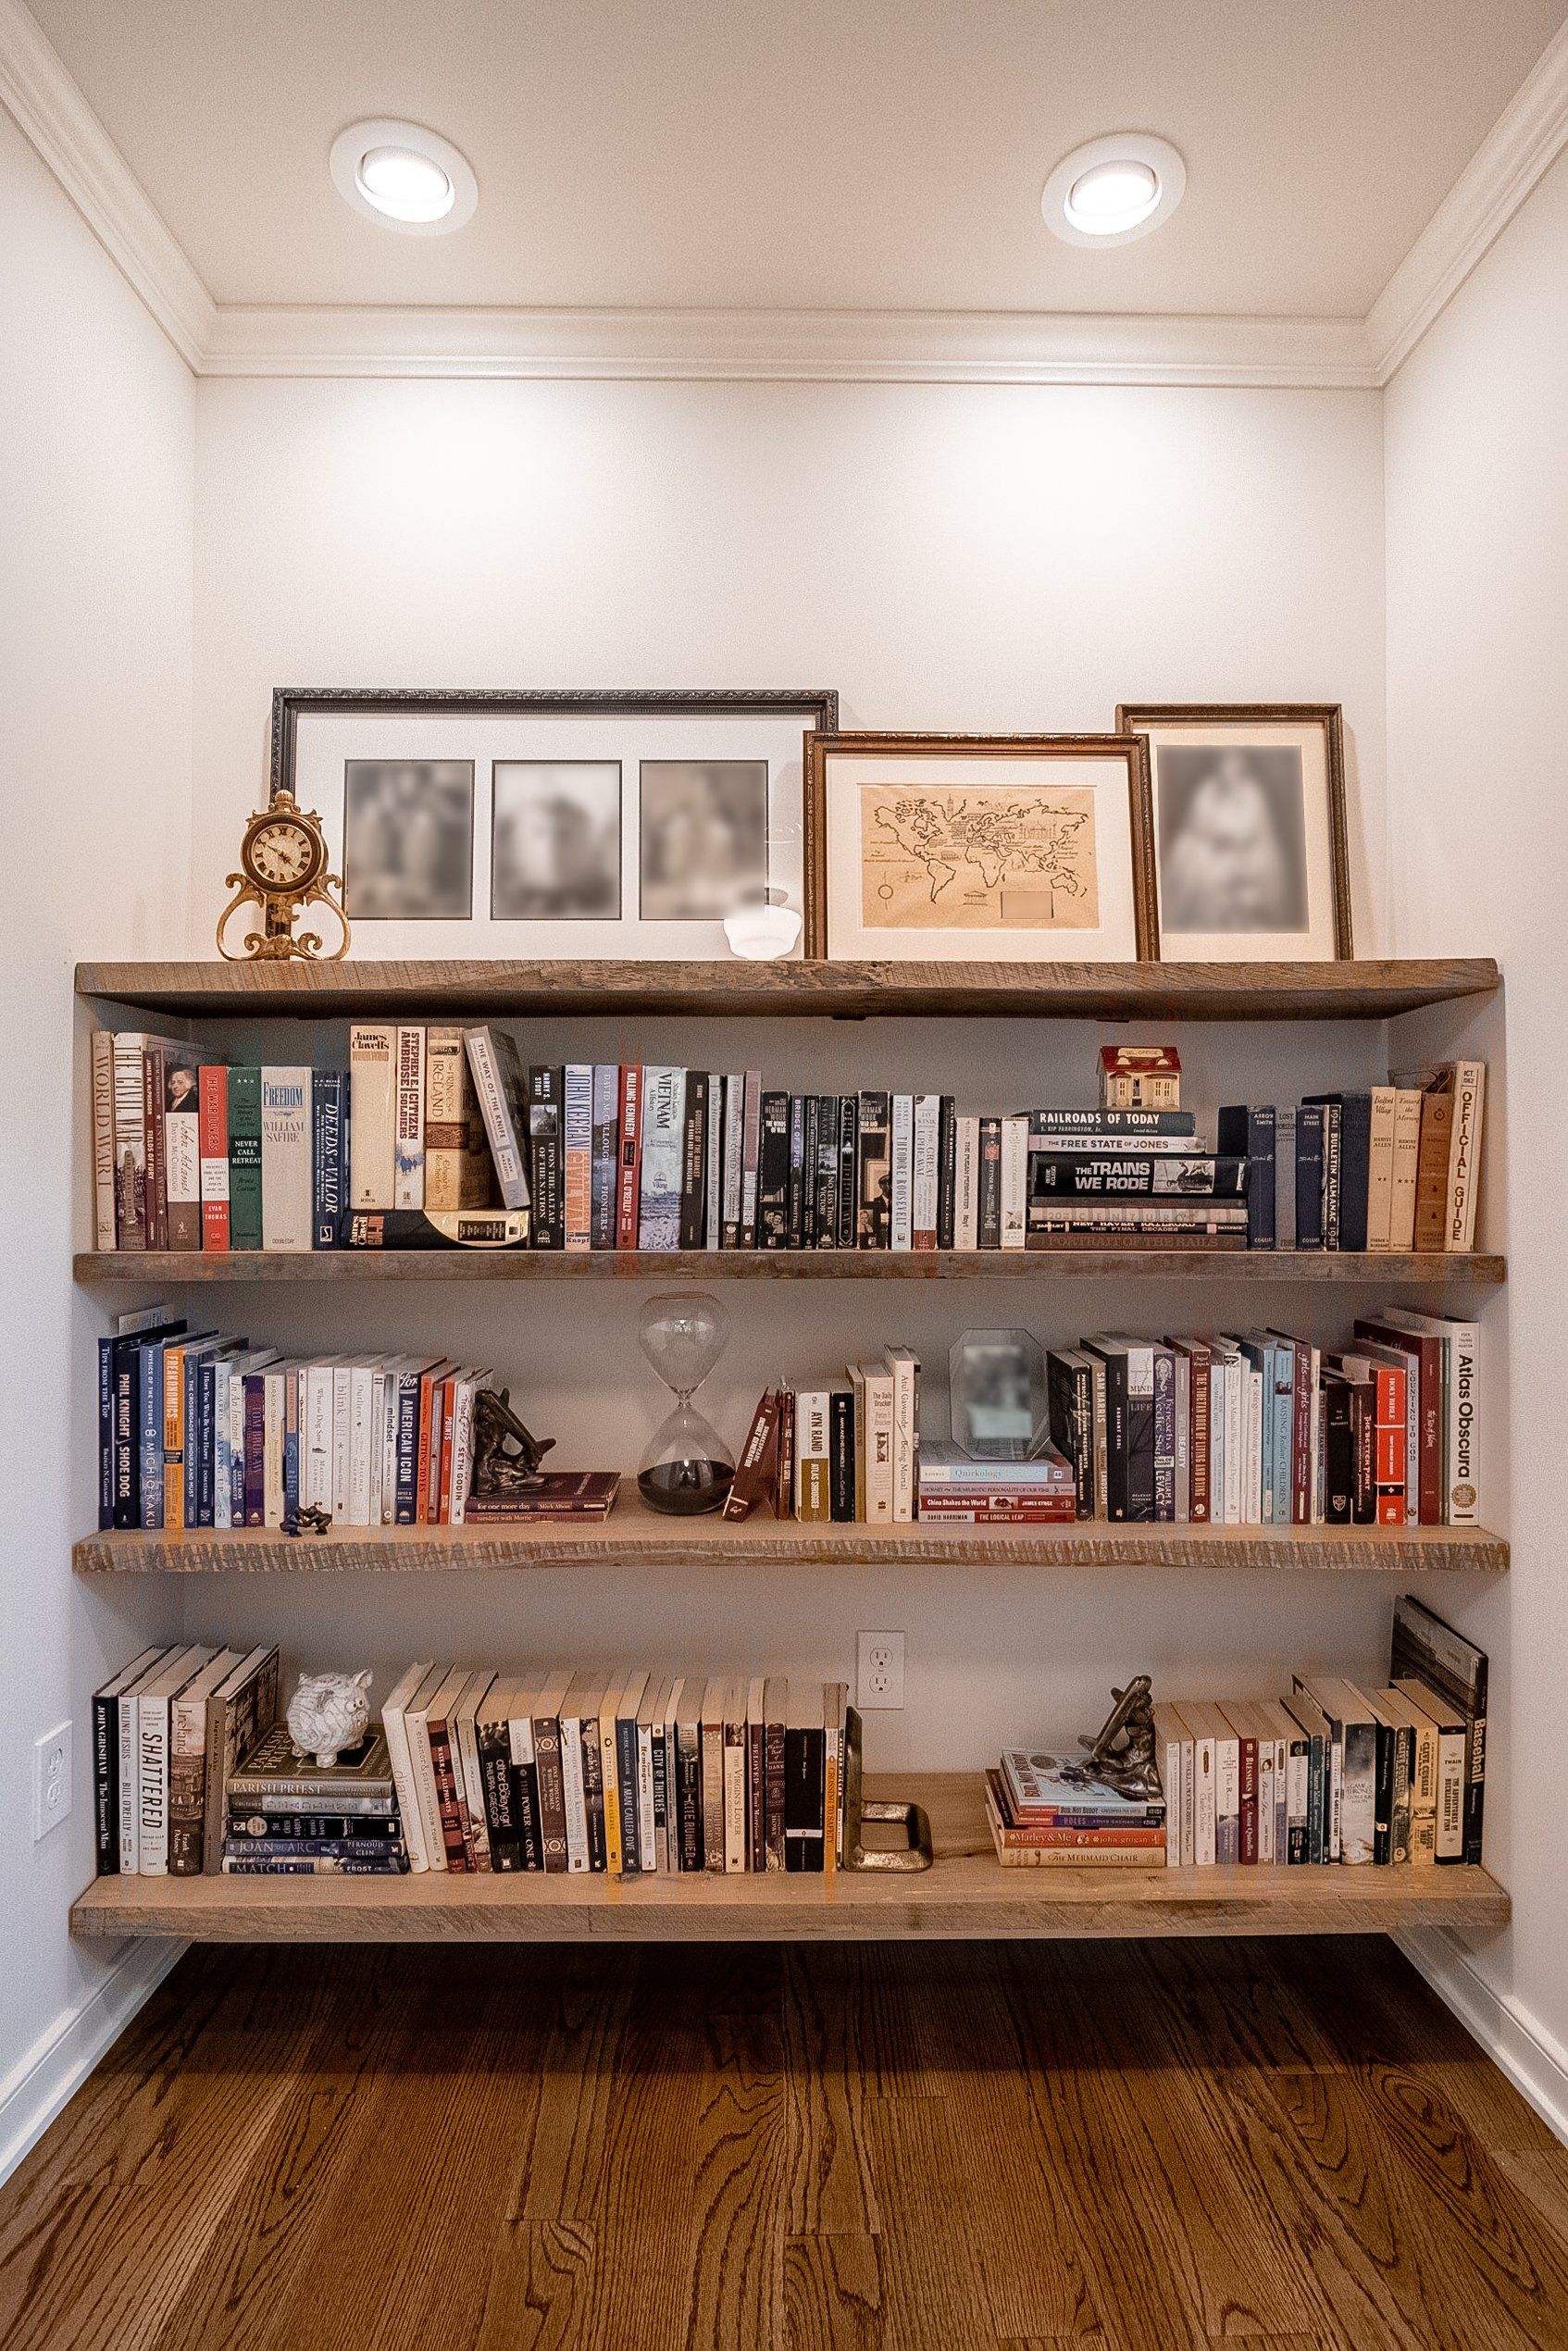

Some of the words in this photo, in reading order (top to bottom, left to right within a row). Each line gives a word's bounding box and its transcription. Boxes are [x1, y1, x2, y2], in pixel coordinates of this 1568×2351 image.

[354, 1032, 386, 1041] James
[114, 1046, 142, 1070] THE
[400, 1031, 409, 1086] AMBROSE
[410, 1033, 419, 1077] STEPHEN
[477, 1043, 485, 1058] THE
[207, 1074, 218, 1090] THE
[480, 1062, 491, 1080] WAY
[94, 1056, 109, 1132] WORLD
[116, 1077, 142, 1113] CIVIL
[263, 1082, 303, 1105] FREEDOM
[486, 1083, 493, 1094] OF
[566, 1071, 590, 1101] JOHN
[626, 1073, 636, 1101] KILLING
[207, 1095, 218, 1113] WAR
[490, 1097, 499, 1113] THE
[656, 1074, 672, 1128] VIETNAM
[263, 1122, 304, 1131] WILLIAM
[325, 1103, 338, 1155] DEEDS
[408, 1093, 417, 1139] CITIZEN
[494, 1114, 505, 1139] KNIFE
[566, 1103, 590, 1148] KEEGAN
[625, 1103, 635, 1137] KENNEDY
[1039, 1113, 1101, 1123] RAILROADS
[1107, 1114, 1121, 1124] OF
[1126, 1113, 1160, 1125] TODAY
[116, 1118, 143, 1143] WAR
[180, 1121, 194, 1147] John
[208, 1117, 218, 1151] LOVERS
[264, 1133, 300, 1142] SAFIRE
[793, 1132, 801, 1143] OF
[1457, 1091, 1473, 1179] OFFICIAL
[96, 1136, 111, 1178] WAR
[147, 1152, 154, 1161] OF
[539, 1147, 545, 1157] OF
[792, 1145, 801, 1167] SPIES
[1062, 1139, 1088, 1148] FREE
[1134, 1140, 1169, 1149] JONES
[1330, 1133, 1338, 1175] BULLETIN
[566, 1152, 583, 1187] CIVIL
[623, 1171, 632, 1184] BILL
[1090, 1162, 1150, 1175] TRAINS
[325, 1167, 338, 1213] VALOR
[1076, 1177, 1103, 1189] WE
[1106, 1177, 1148, 1189] RODE
[566, 1189, 583, 1232] WAR
[623, 1187, 632, 1213] O'REILLY
[1329, 1177, 1338, 1222] ALMANAC
[1453, 1187, 1464, 1240] GUIDE
[119, 1375, 129, 1397] PHIL
[167, 1356, 178, 1419] FREAKONOMICS
[1459, 1354, 1474, 1399] Atlas
[336, 1386, 346, 1415] blink
[900, 1395, 908, 1428] Gawande
[119, 1399, 129, 1437] KNIGHT
[385, 1408, 395, 1442] mindset
[400, 1399, 413, 1453] AMERICAN
[811, 1412, 823, 1427] AYN
[189, 1433, 193, 1441] OF
[810, 1431, 822, 1451] RAND
[1458, 1402, 1473, 1477] Obscura
[119, 1447, 129, 1473] SHOE
[457, 1447, 466, 1471] SETH
[900, 1440, 908, 1462] Being
[145, 1442, 155, 1488] MICHIO
[400, 1457, 411, 1482] ICON
[900, 1464, 908, 1490] Mortal
[119, 1475, 129, 1497] DOG
[454, 1473, 464, 1500] GODIN
[1156, 1471, 1164, 1505] LEVACY
[145, 1493, 155, 1526] KAKU
[121, 1704, 130, 1734] KILLING
[177, 1710, 192, 1754] Ireland
[654, 1749, 663, 1768] CITY
[1422, 1743, 1430, 1761] CLIVE
[1471, 1719, 1486, 1784] Baseball
[142, 1733, 162, 1829] SHATTERED
[233, 1784, 279, 1794] PARISH
[280, 1785, 323, 1795] PRIEST
[486, 1762, 494, 1791] PHILIPPA
[1421, 1763, 1430, 1797] CUSSLER
[122, 1783, 131, 1797] BILL
[624, 1787, 633, 1805] MAN
[655, 1781, 665, 1812] THIEVES
[489, 1793, 499, 1827] GREGORY
[624, 1808, 633, 1834] CALLED
[625, 1836, 635, 1850] OVE
[236, 1863, 286, 1873] MATCH
